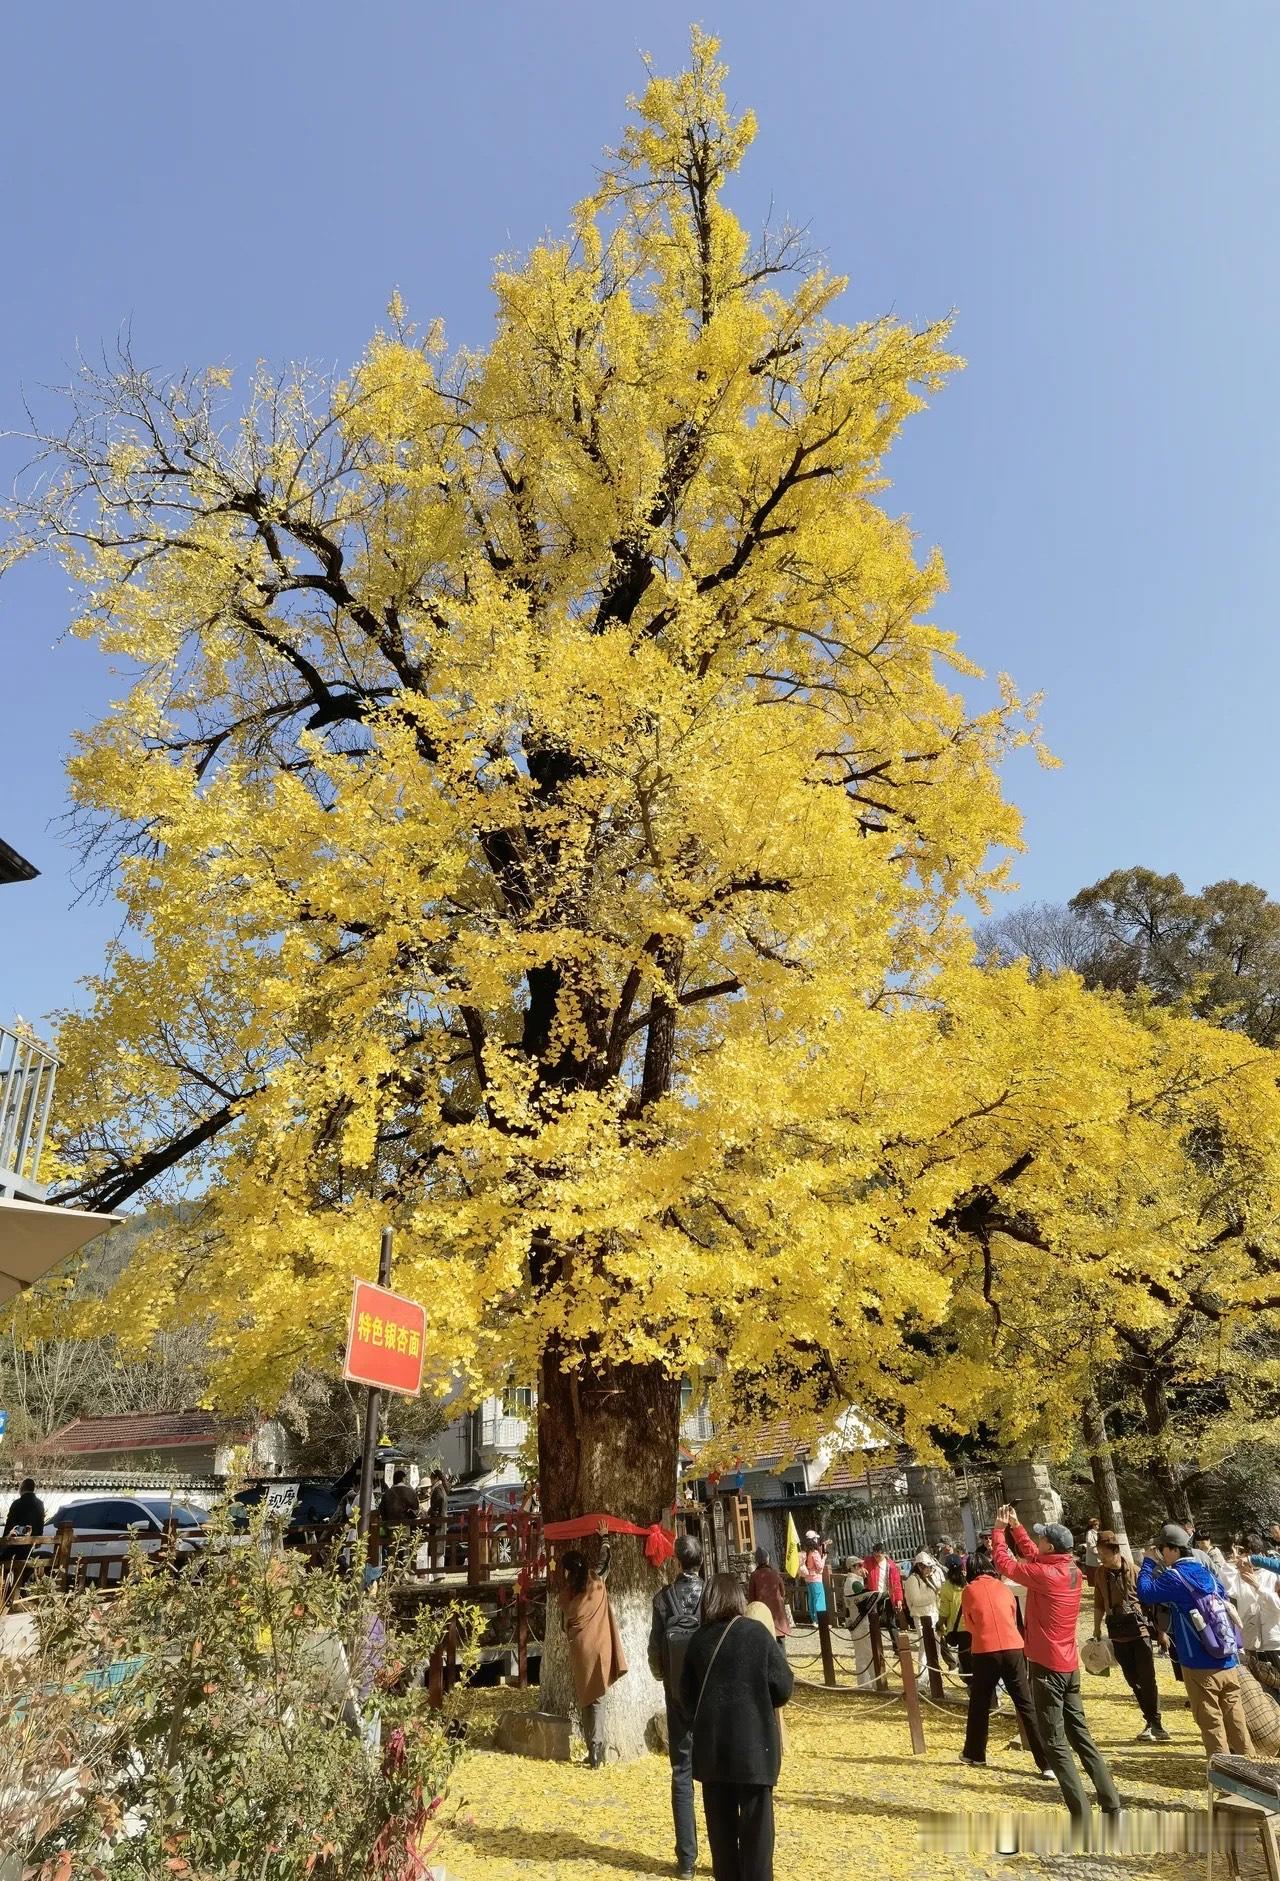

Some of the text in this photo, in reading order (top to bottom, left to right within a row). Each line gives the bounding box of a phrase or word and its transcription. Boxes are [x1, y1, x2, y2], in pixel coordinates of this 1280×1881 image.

[357, 1311, 420, 1359] 特色银杏面
